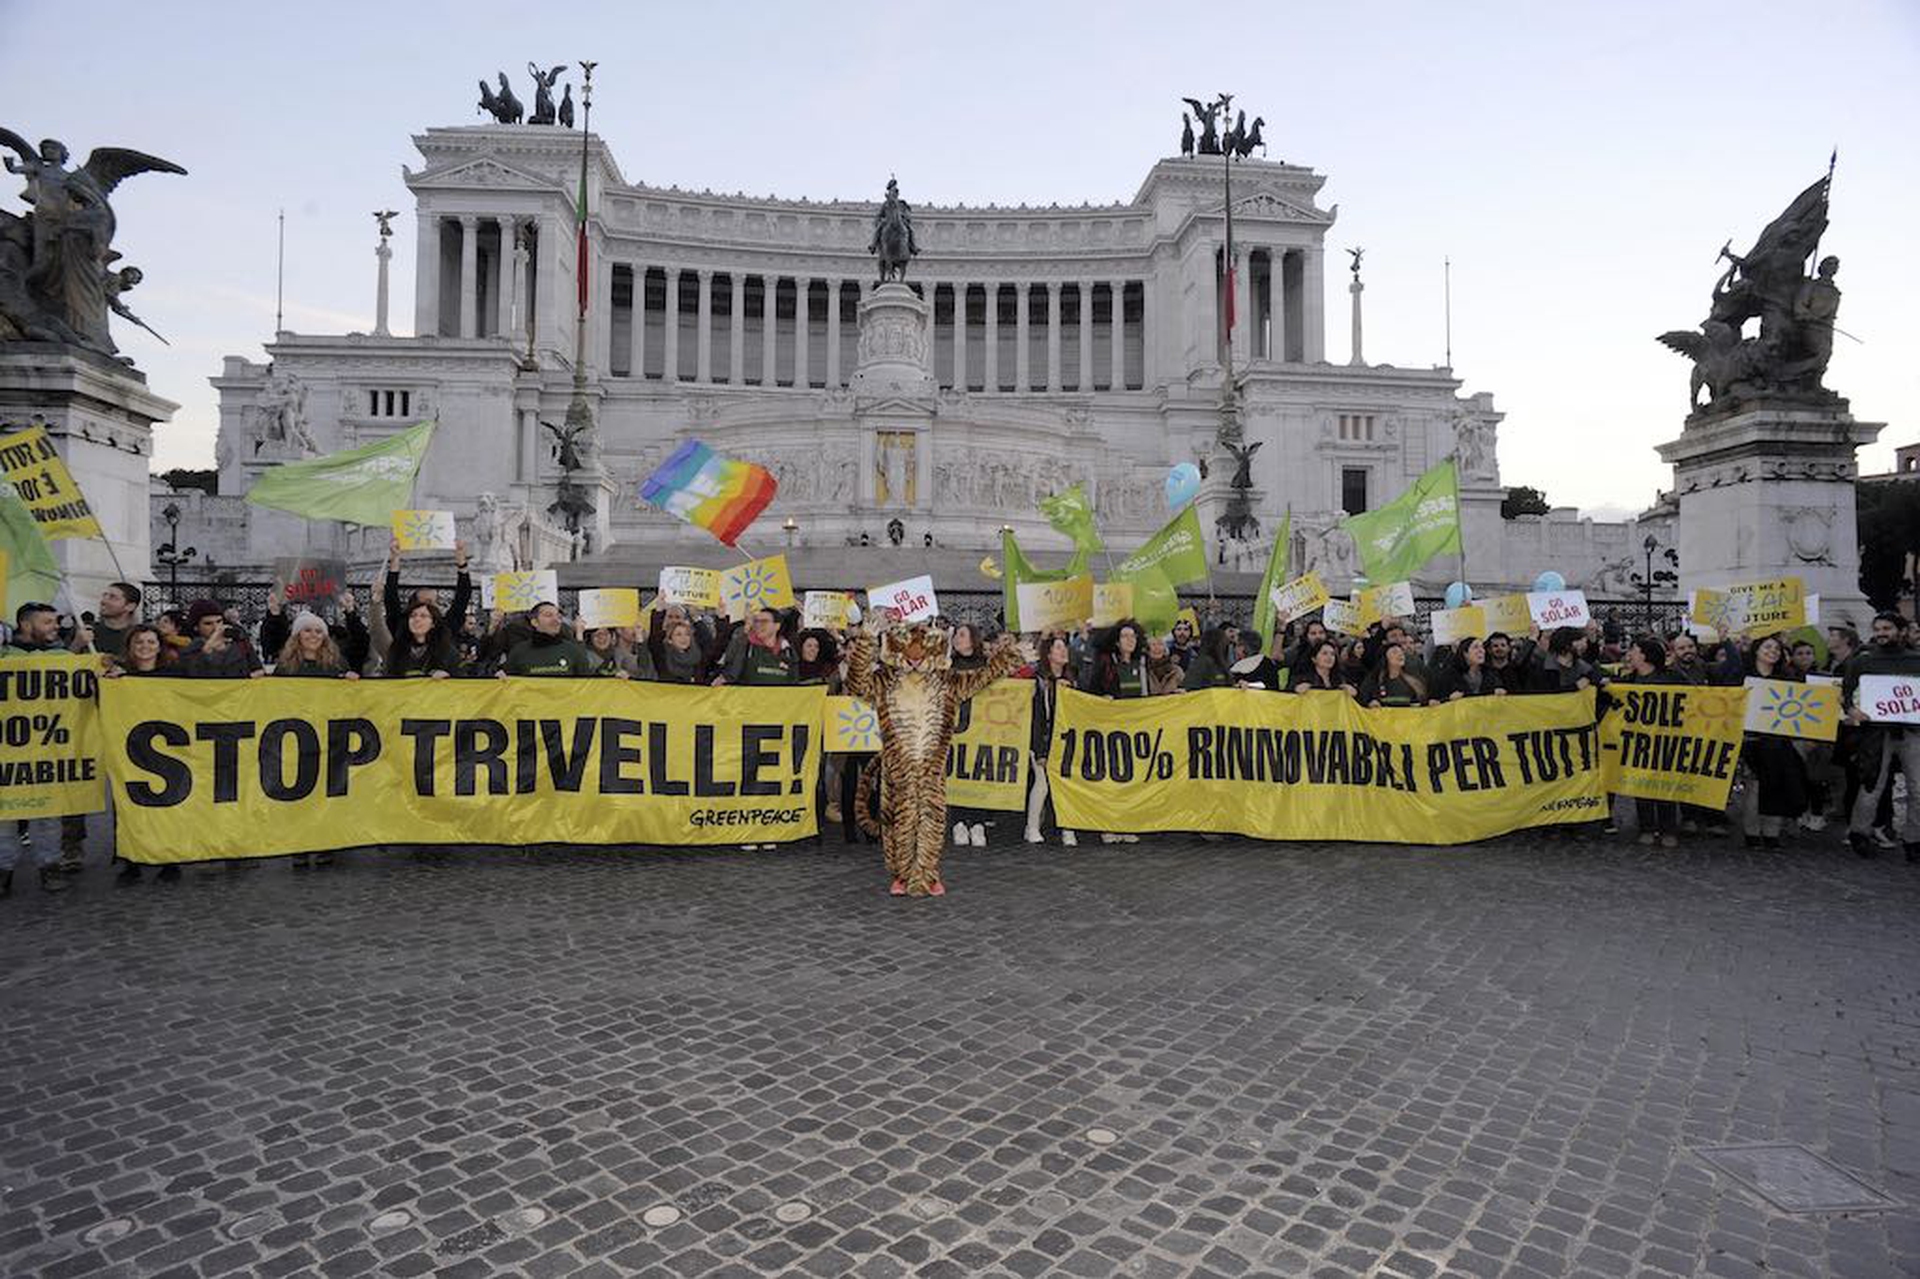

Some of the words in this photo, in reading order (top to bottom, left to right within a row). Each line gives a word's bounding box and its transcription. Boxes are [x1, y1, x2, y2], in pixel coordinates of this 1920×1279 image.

[893, 590, 910, 604] GO
[1730, 585, 1753, 595] GIVE
[1759, 583, 1774, 591] ME
[1550, 597, 1564, 608] GO
[1540, 605, 1582, 624] SOLAR
[1742, 611, 1790, 624] UTURE
[1892, 685, 1914, 699] GO
[125, 717, 382, 808] STOP
[401, 716, 809, 798] TRIVELLE!
[946, 743, 1019, 783] LAR
[1060, 727, 1174, 783] 100%
[1427, 737, 1506, 794] PER
[690, 807, 807, 829] GREENPEACE
